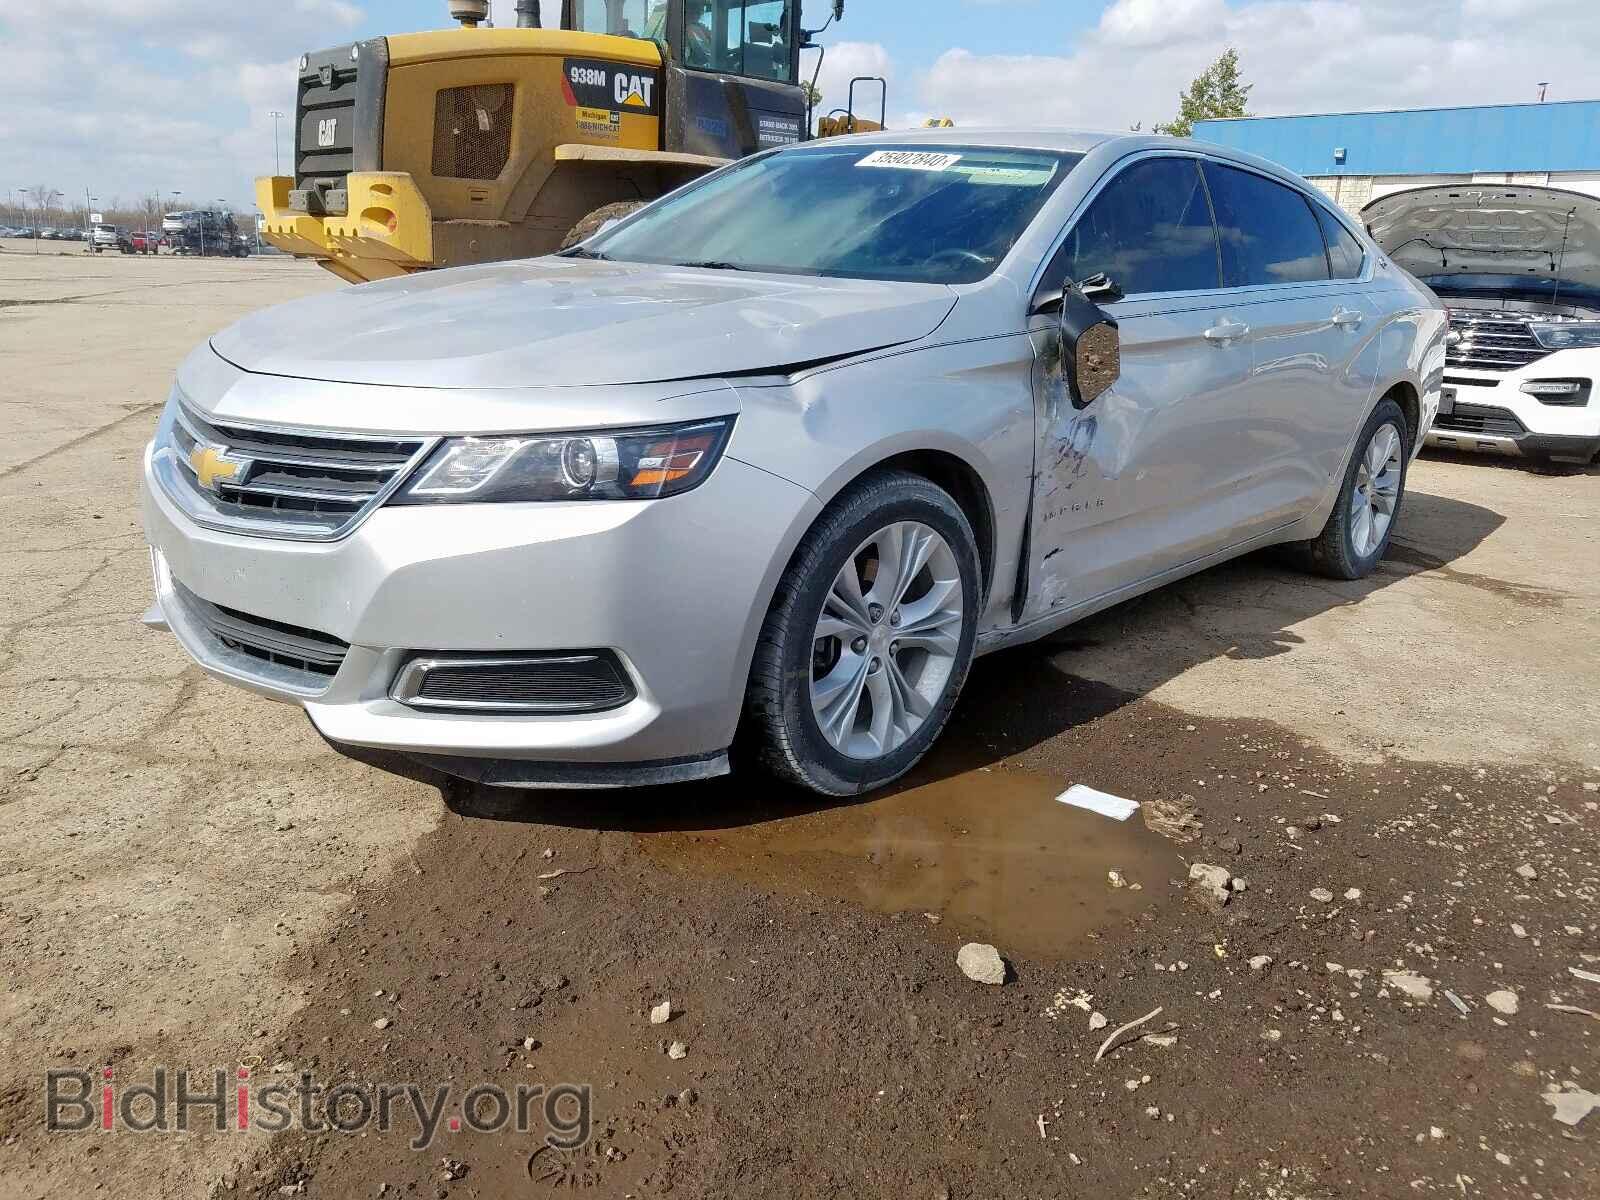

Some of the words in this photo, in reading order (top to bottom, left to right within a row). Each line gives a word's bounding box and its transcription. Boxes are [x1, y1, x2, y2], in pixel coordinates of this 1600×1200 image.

[570, 66, 606, 87] 938M
[614, 72, 654, 108] CAT
[581, 111, 608, 121] Michigan
[318, 118, 337, 147] CAT
